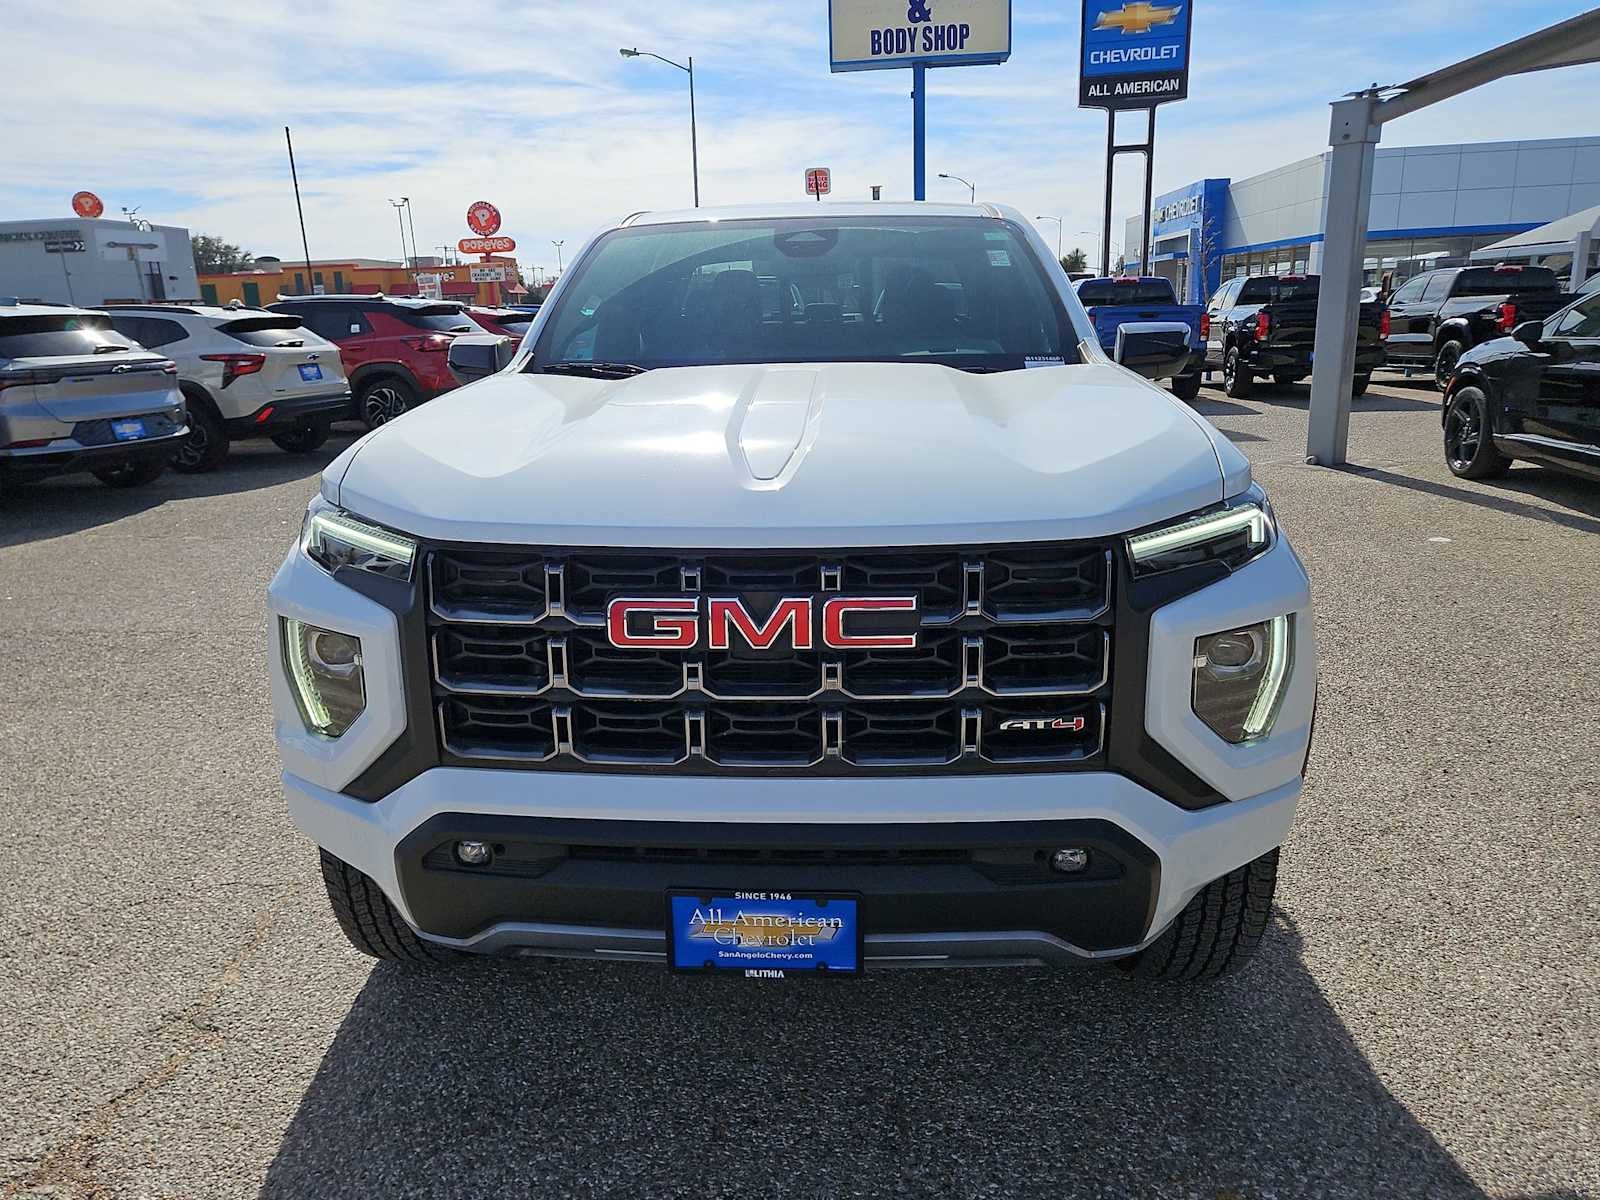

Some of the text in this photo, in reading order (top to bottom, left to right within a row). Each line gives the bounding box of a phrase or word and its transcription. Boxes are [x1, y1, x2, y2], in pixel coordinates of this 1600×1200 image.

[908, 0, 931, 23] &
[871, 24, 970, 56] BODY SHOP
[1090, 45, 1180, 64] CHEVROLET
[1088, 79, 1180, 96] ALL AMERICAN
[607, 596, 918, 650] GMC
[1000, 717, 1084, 731] AT4
[735, 892, 792, 901] SINCE 1946
[688, 908, 843, 928] All American
[713, 927, 816, 946] Chevrolet
[718, 951, 813, 959] SanAngeloChevy.com
[754, 969, 785, 978] LITHIA
